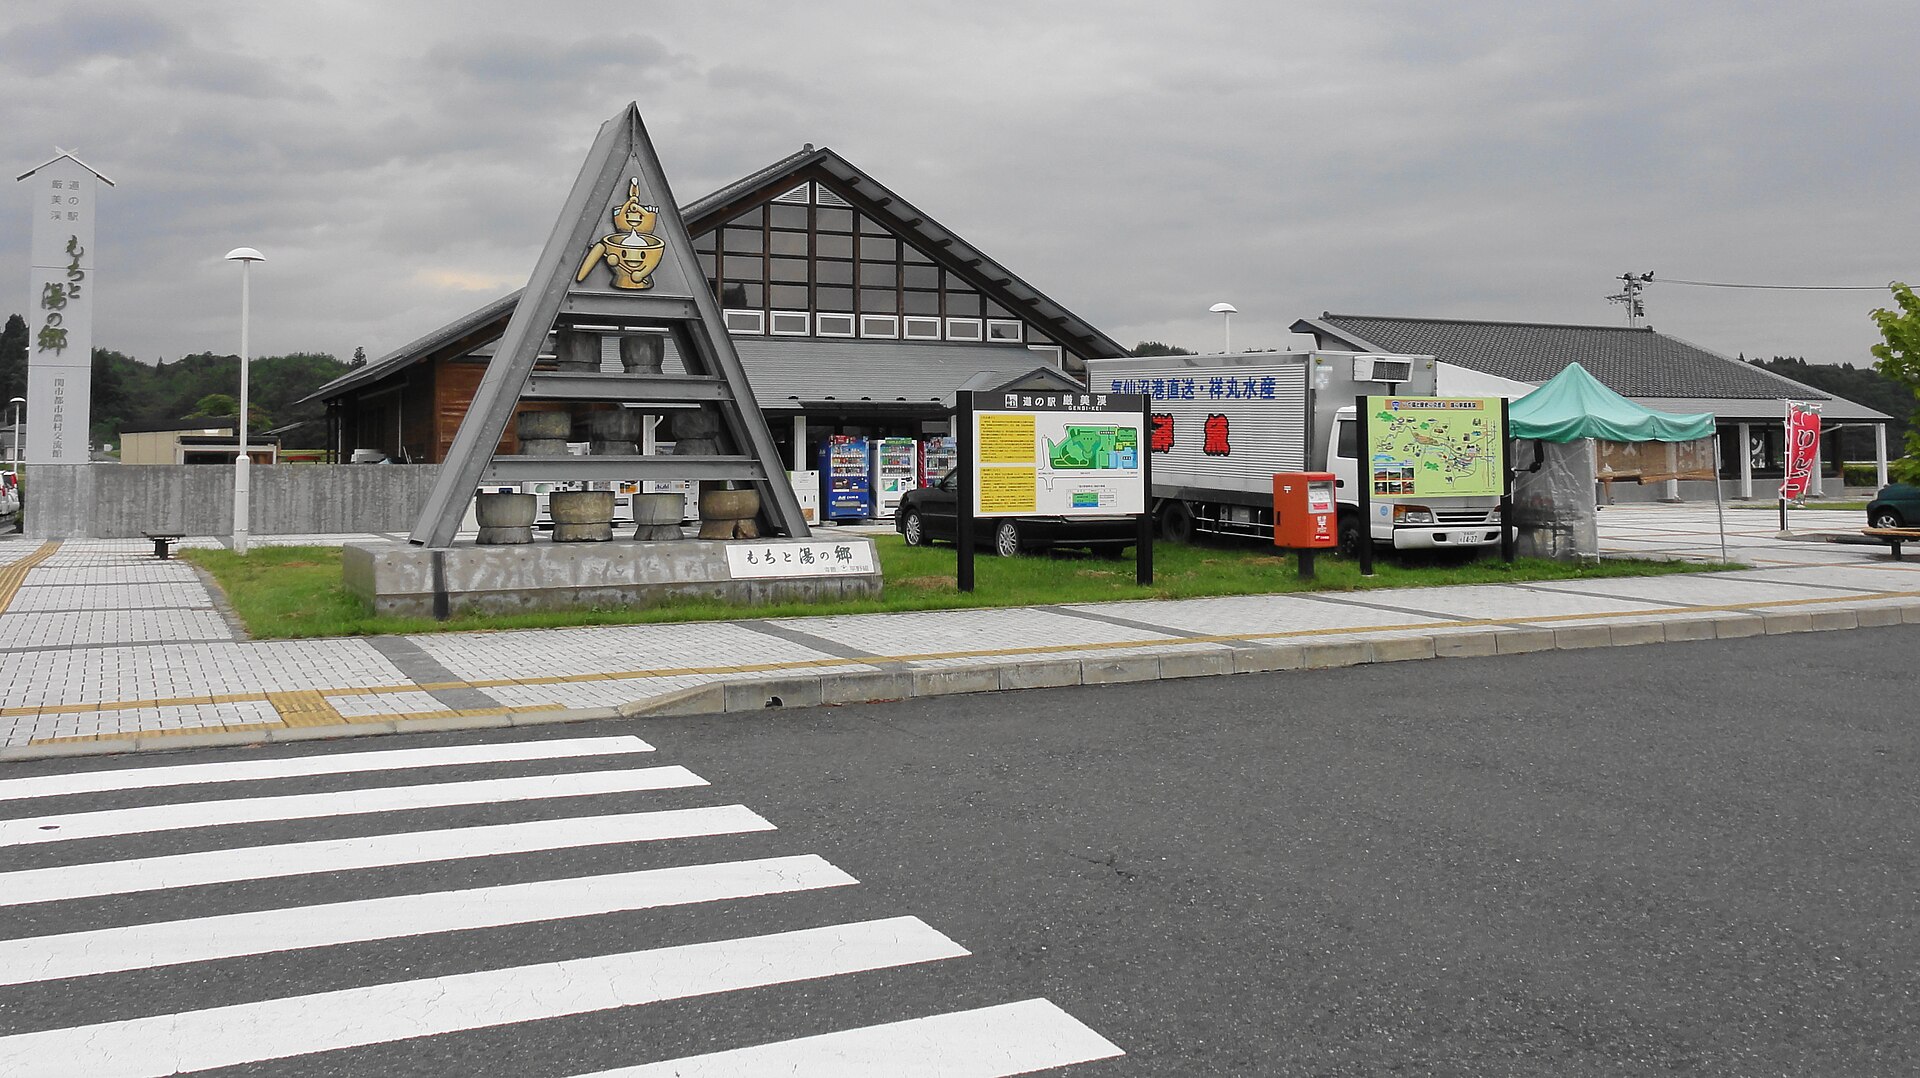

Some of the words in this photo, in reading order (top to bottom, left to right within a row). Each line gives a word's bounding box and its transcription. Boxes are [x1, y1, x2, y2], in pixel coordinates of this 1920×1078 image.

[67, 180, 80, 221] 道の駅
[1022, 396, 1057, 407] 道の駅
[747, 544, 853, 565] もちと湯の郷
